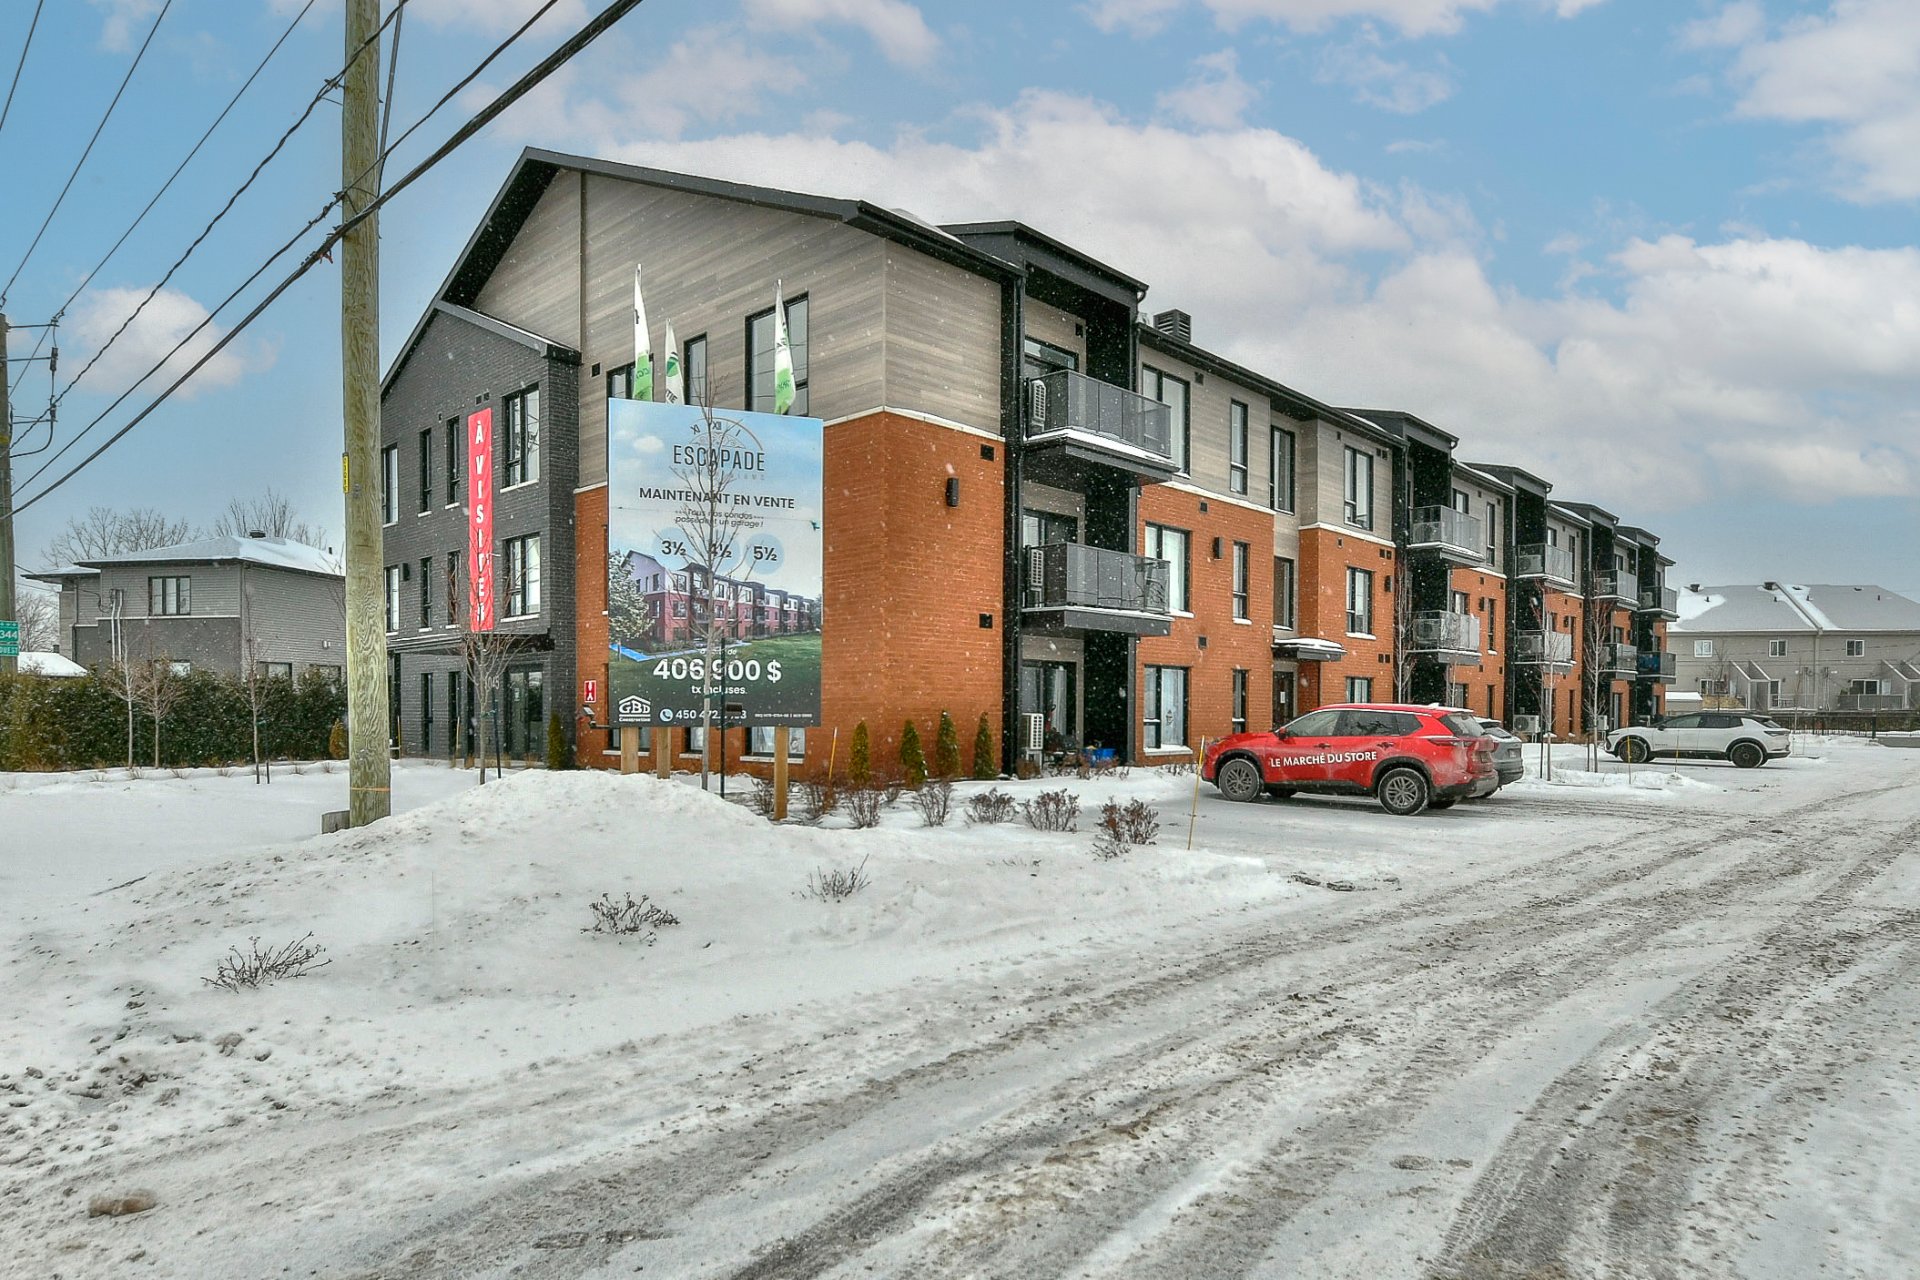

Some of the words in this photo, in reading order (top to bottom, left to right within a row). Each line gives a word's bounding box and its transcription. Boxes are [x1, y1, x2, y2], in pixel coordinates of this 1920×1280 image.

[673, 445, 765, 471] ESCAPADE
[639, 487, 730, 504] MAINTENANT
[733, 494, 750, 506] EN
[754, 495, 795, 509] VENTE
[767, 659, 782, 683] $
[691, 685, 702, 694] tx
[675, 709, 697, 719] 450
[1270, 758, 1281, 767] LE
[1283, 753, 1326, 767] MARCHÉ
[1327, 753, 1343, 763] DU
[1344, 751, 1377, 762] STORE
